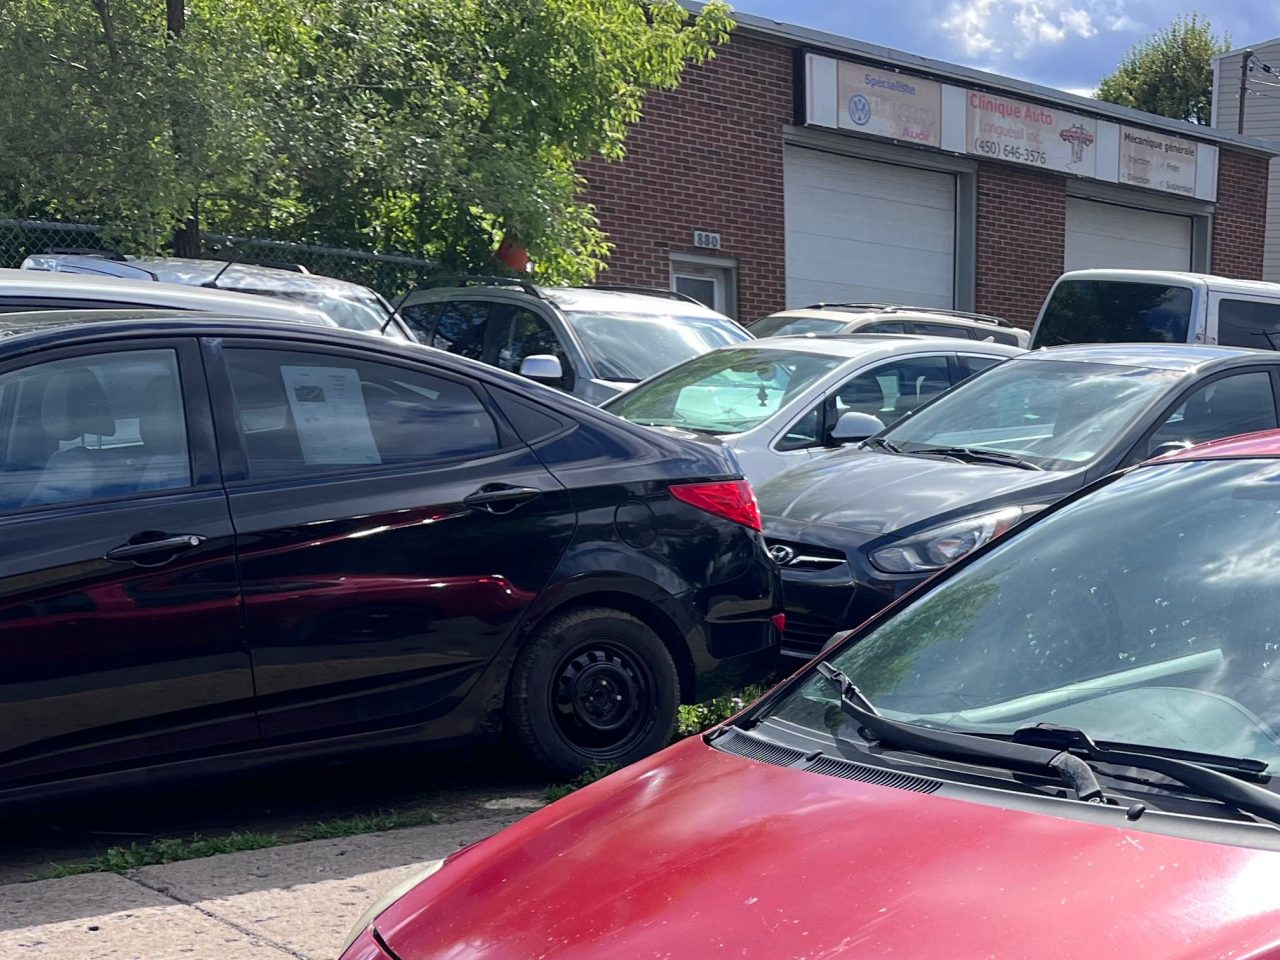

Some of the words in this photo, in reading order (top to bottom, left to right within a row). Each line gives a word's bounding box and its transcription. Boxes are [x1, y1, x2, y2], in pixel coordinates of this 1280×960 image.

[969, 93, 1021, 118] Clinique
[1024, 105, 1053, 126] Auto
[974, 137, 1000, 158] (450)
[1003, 144, 1047, 165] 646-3576
[1124, 132, 1163, 150] Mécanique
[1164, 143, 1195, 157] générale
[697, 232, 718, 248] 880
